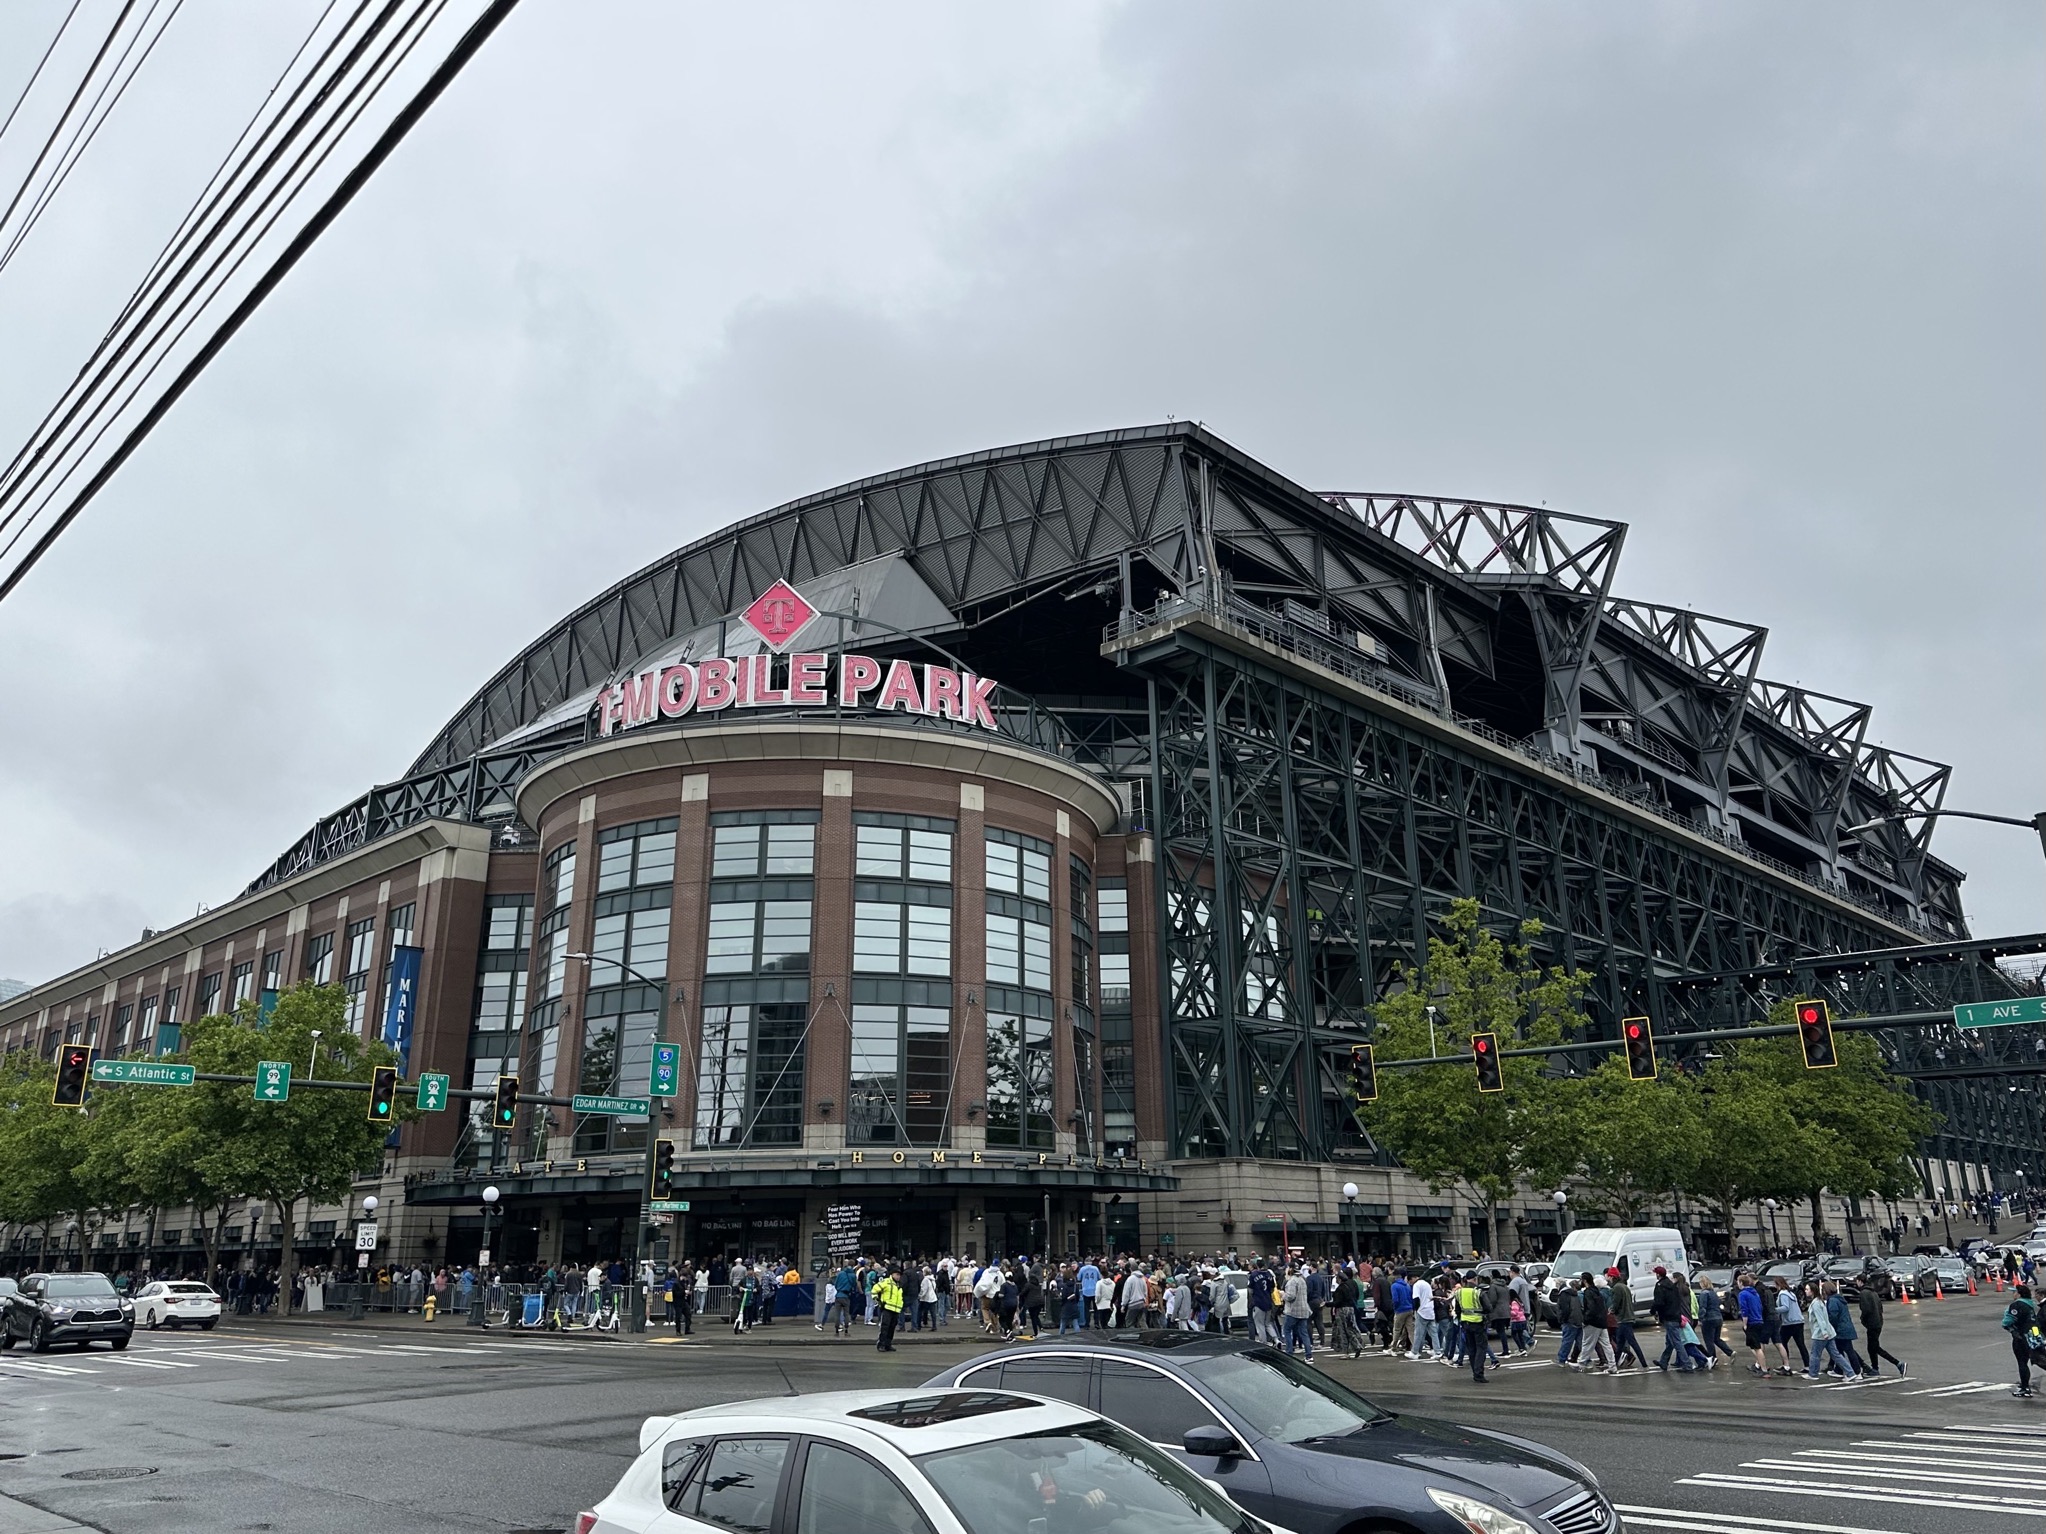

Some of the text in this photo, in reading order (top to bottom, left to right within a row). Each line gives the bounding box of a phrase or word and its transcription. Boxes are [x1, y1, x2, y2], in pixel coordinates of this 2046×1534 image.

[597, 653, 999, 737] T-MOBILE PARK
[1966, 1009, 1974, 1021] 1
[1993, 1005, 2021, 1018] AVE
[662, 1052, 669, 1060] 5
[115, 1067, 190, 1081] S Atlantic St
[268, 1072, 279, 1080] 99
[658, 1069, 670, 1078] 90
[429, 1082, 439, 1091] 99
[575, 1098, 637, 1110] EDGAR MARTINEZ DR
[852, 1151, 1146, 1169] HOME PLATE
[763, 1220, 778, 1228] BAG
[359, 1237, 374, 1247] 30
[1084, 1272, 1095, 1280] 44
[1262, 1280, 1268, 1291] 3
